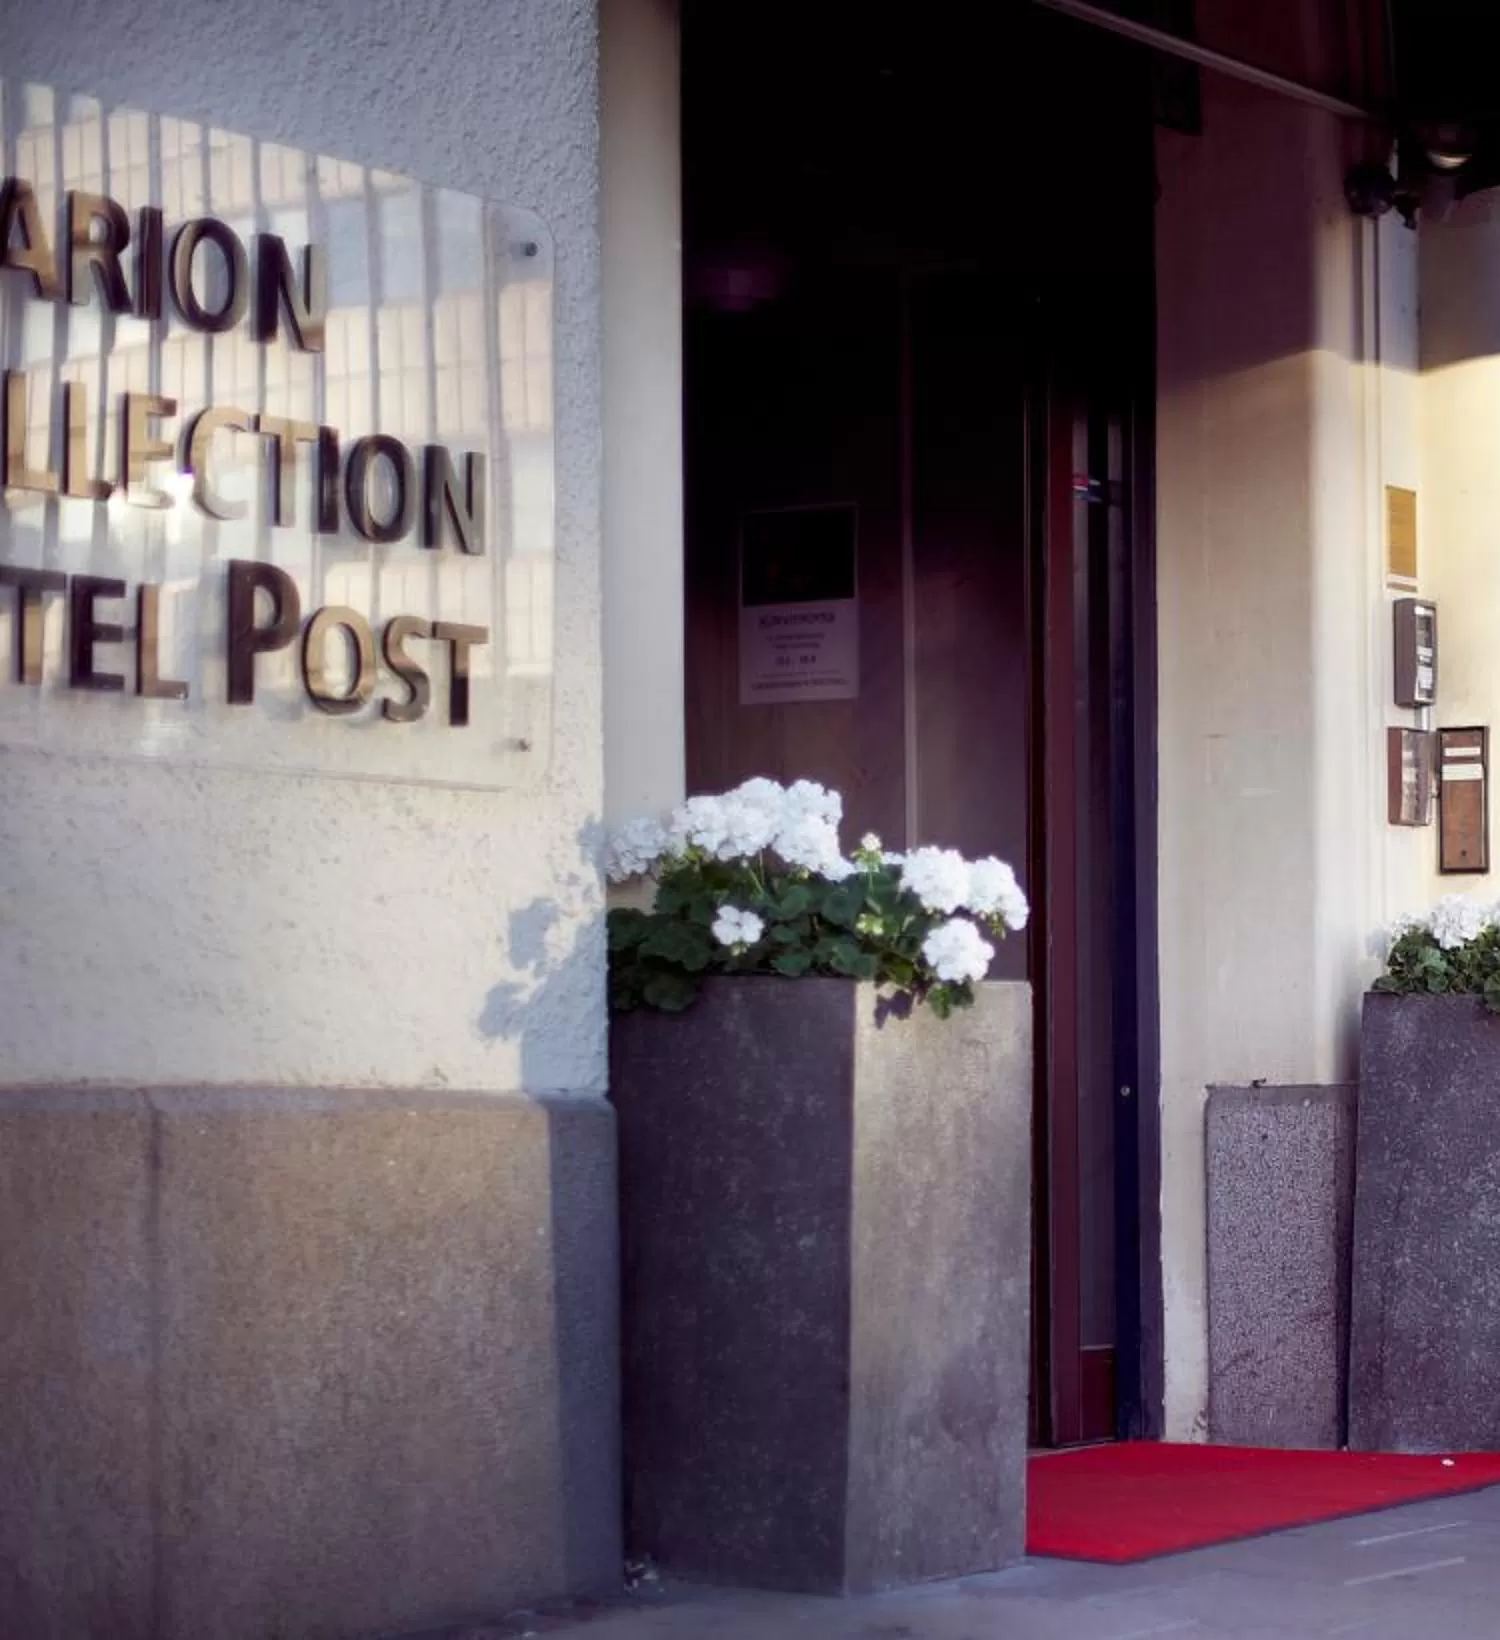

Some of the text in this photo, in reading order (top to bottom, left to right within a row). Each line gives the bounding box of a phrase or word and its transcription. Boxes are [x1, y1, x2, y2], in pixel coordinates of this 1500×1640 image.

[0, 174, 325, 353] ARION
[2, 368, 486, 556] LLECTION
[0, 564, 190, 699] TEL
